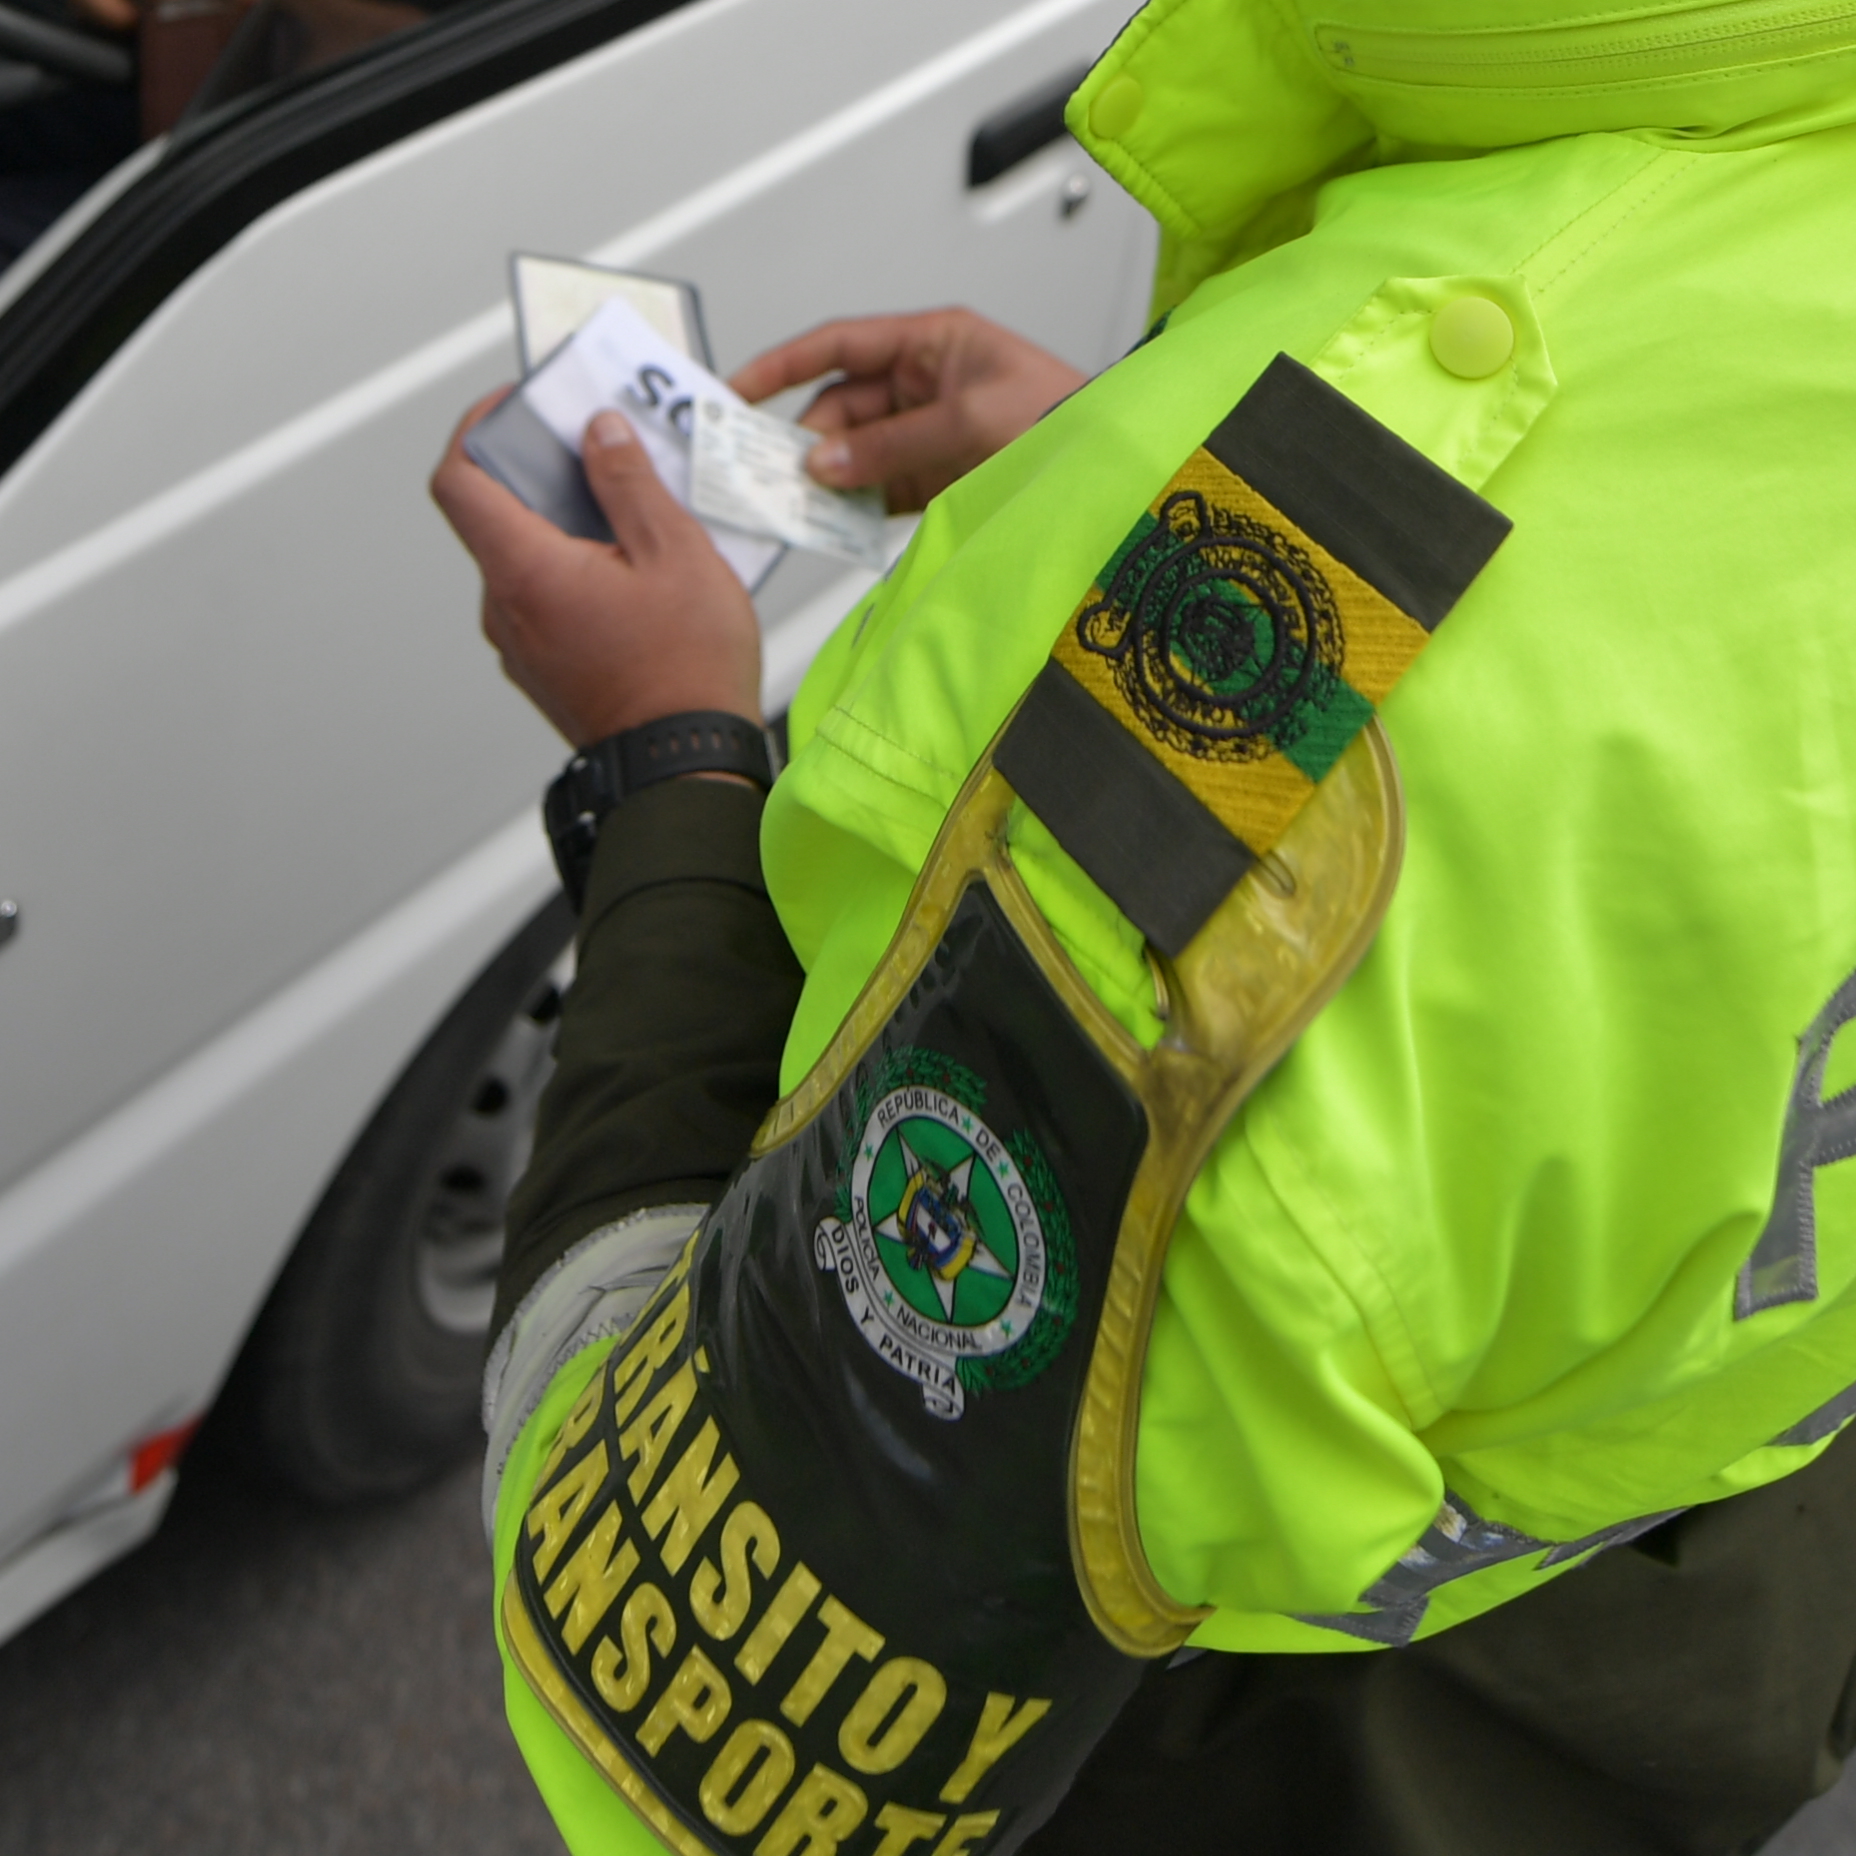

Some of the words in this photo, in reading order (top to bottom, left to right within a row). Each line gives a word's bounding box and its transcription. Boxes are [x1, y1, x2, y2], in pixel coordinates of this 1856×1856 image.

[876, 1085, 960, 1128] REPÚBLICA
[975, 1128, 1001, 1163] DE
[1007, 1182, 1042, 1308] COLOMBIA
[831, 1225, 860, 1295] DIOS
[858, 1308, 874, 1326] Y
[879, 1335, 957, 1395] PATRIA
[896, 1305, 983, 1350] NACIONAL
[939, 1691, 1052, 1805] Y
